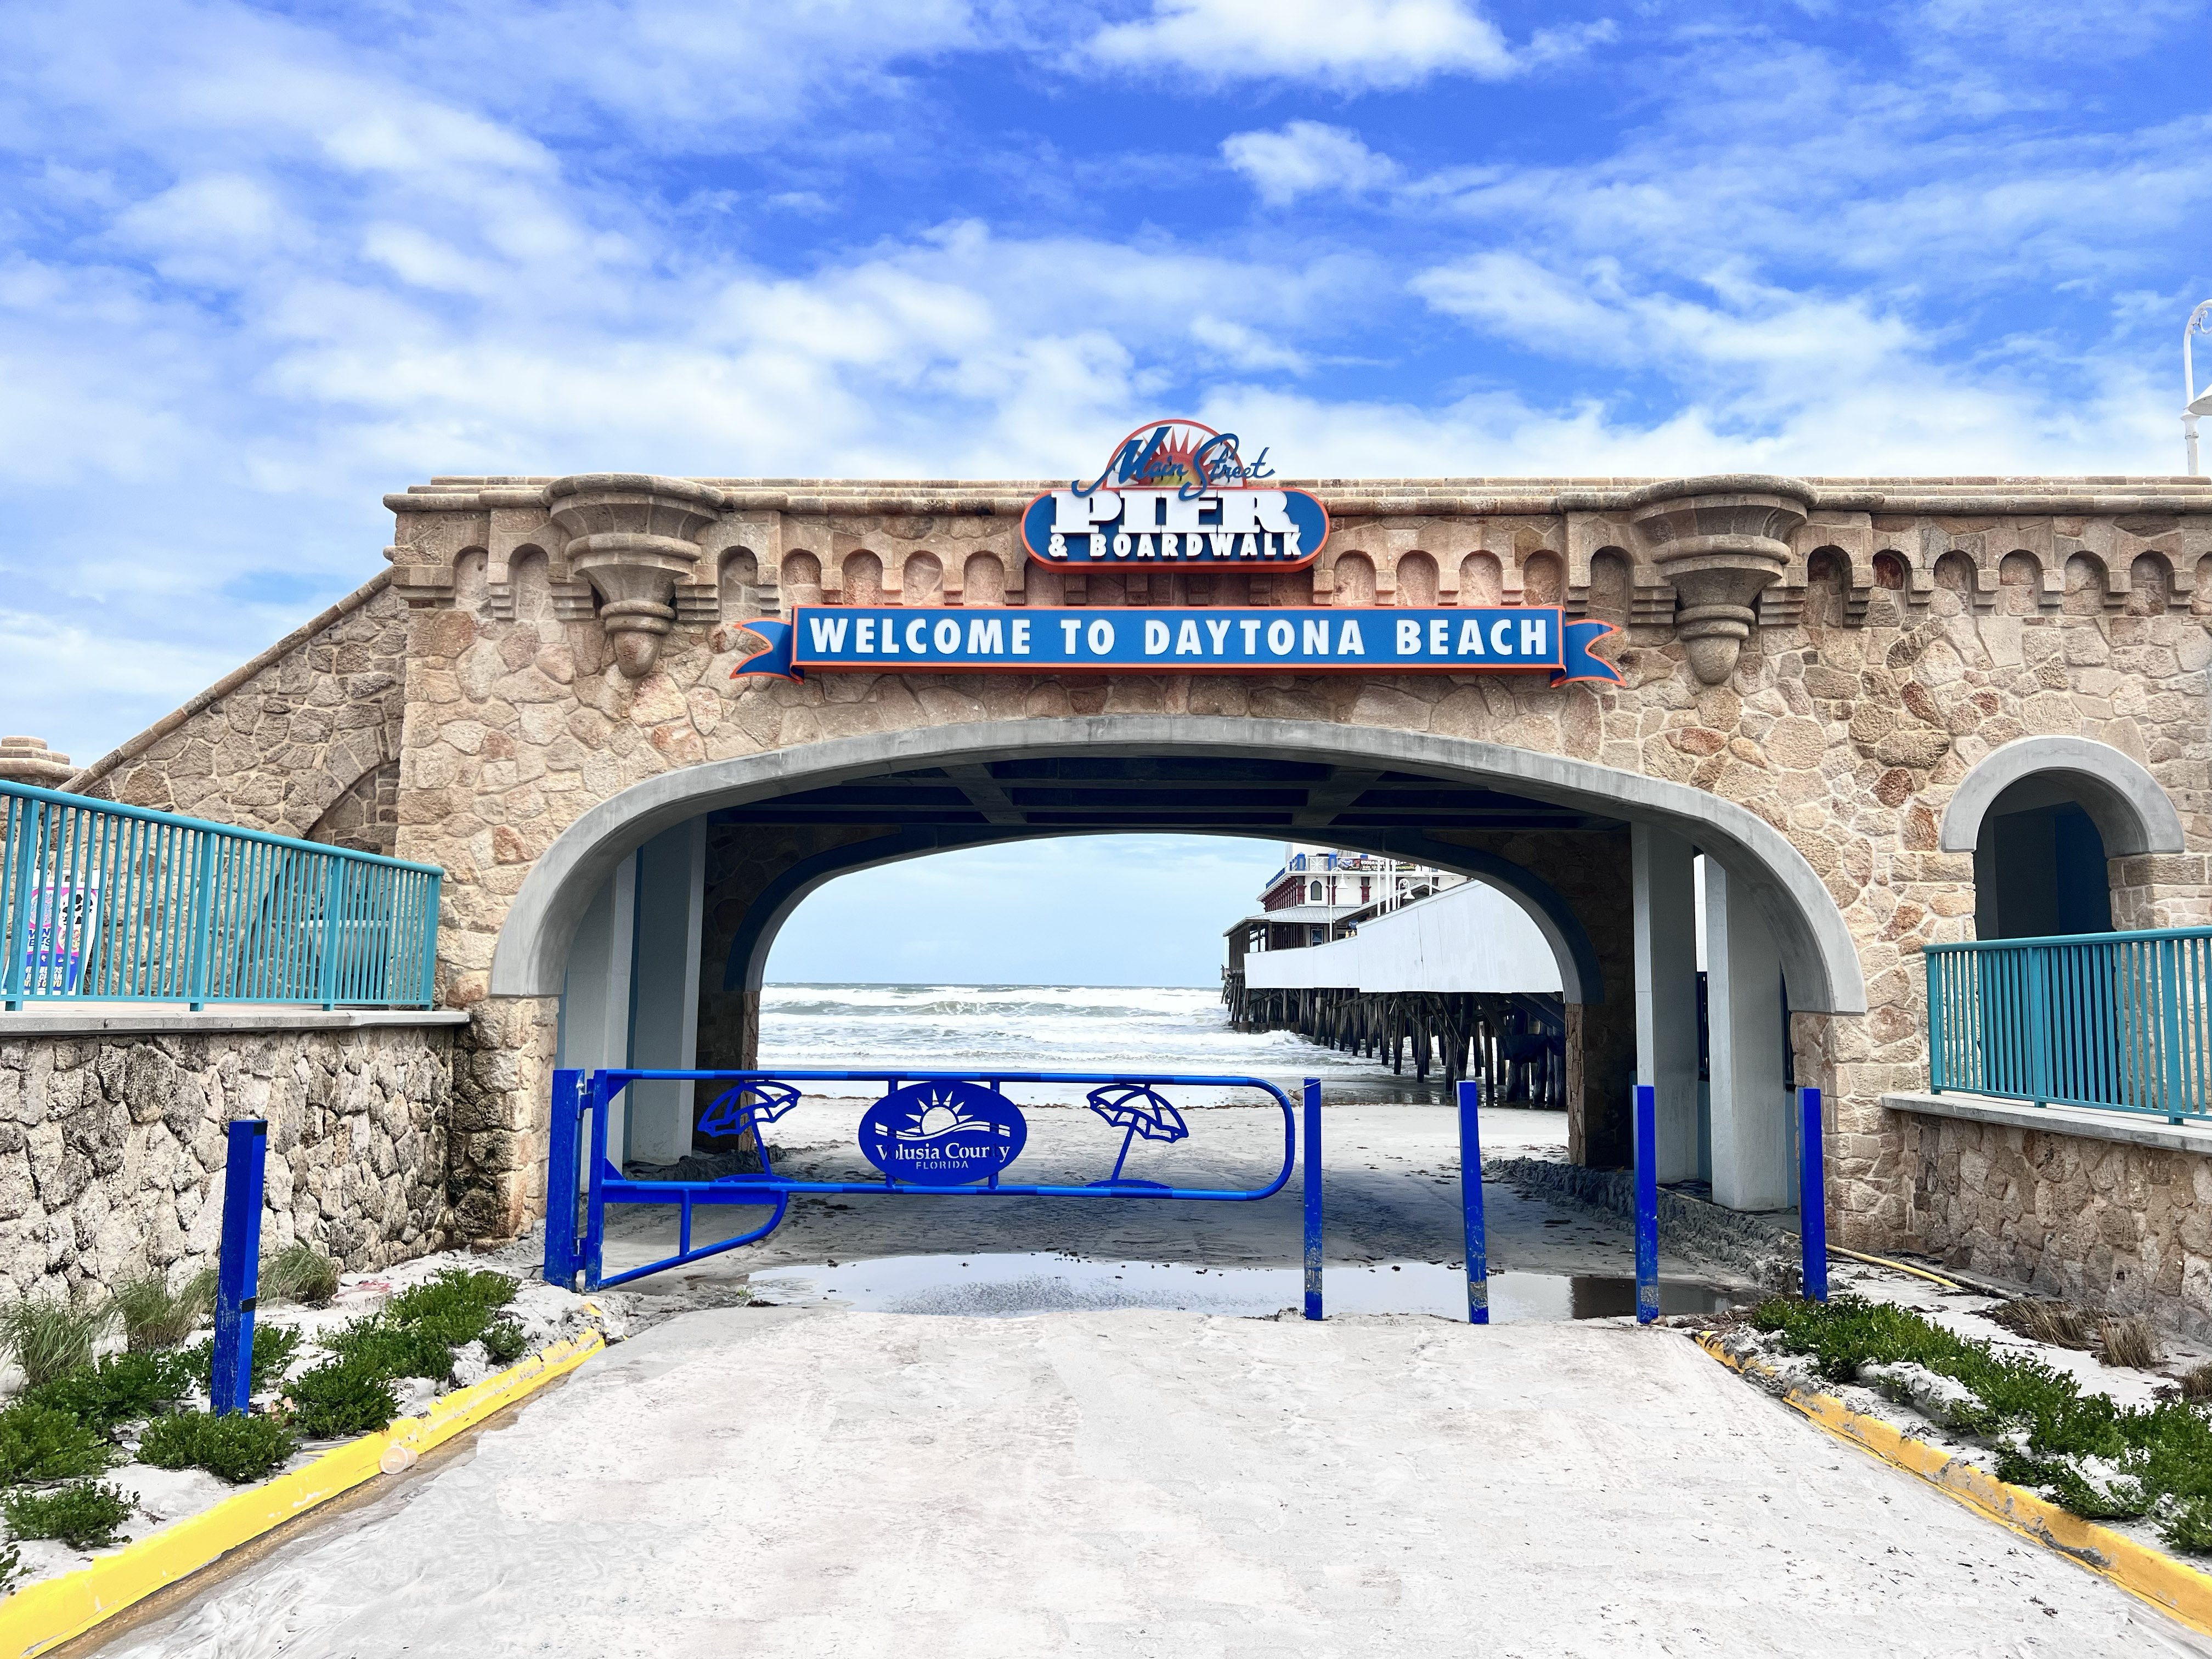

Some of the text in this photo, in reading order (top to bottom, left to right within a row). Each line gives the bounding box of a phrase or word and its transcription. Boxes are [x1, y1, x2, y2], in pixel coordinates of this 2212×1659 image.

[1071, 426, 1276, 501] Main Street
[1051, 490, 1300, 534] PIER
[1048, 533, 1302, 558] & BOARDWALK
[809, 617, 1547, 656] WELCOME TO DAYTONA BEACH
[916, 1160, 969, 1170] FLORIDA
